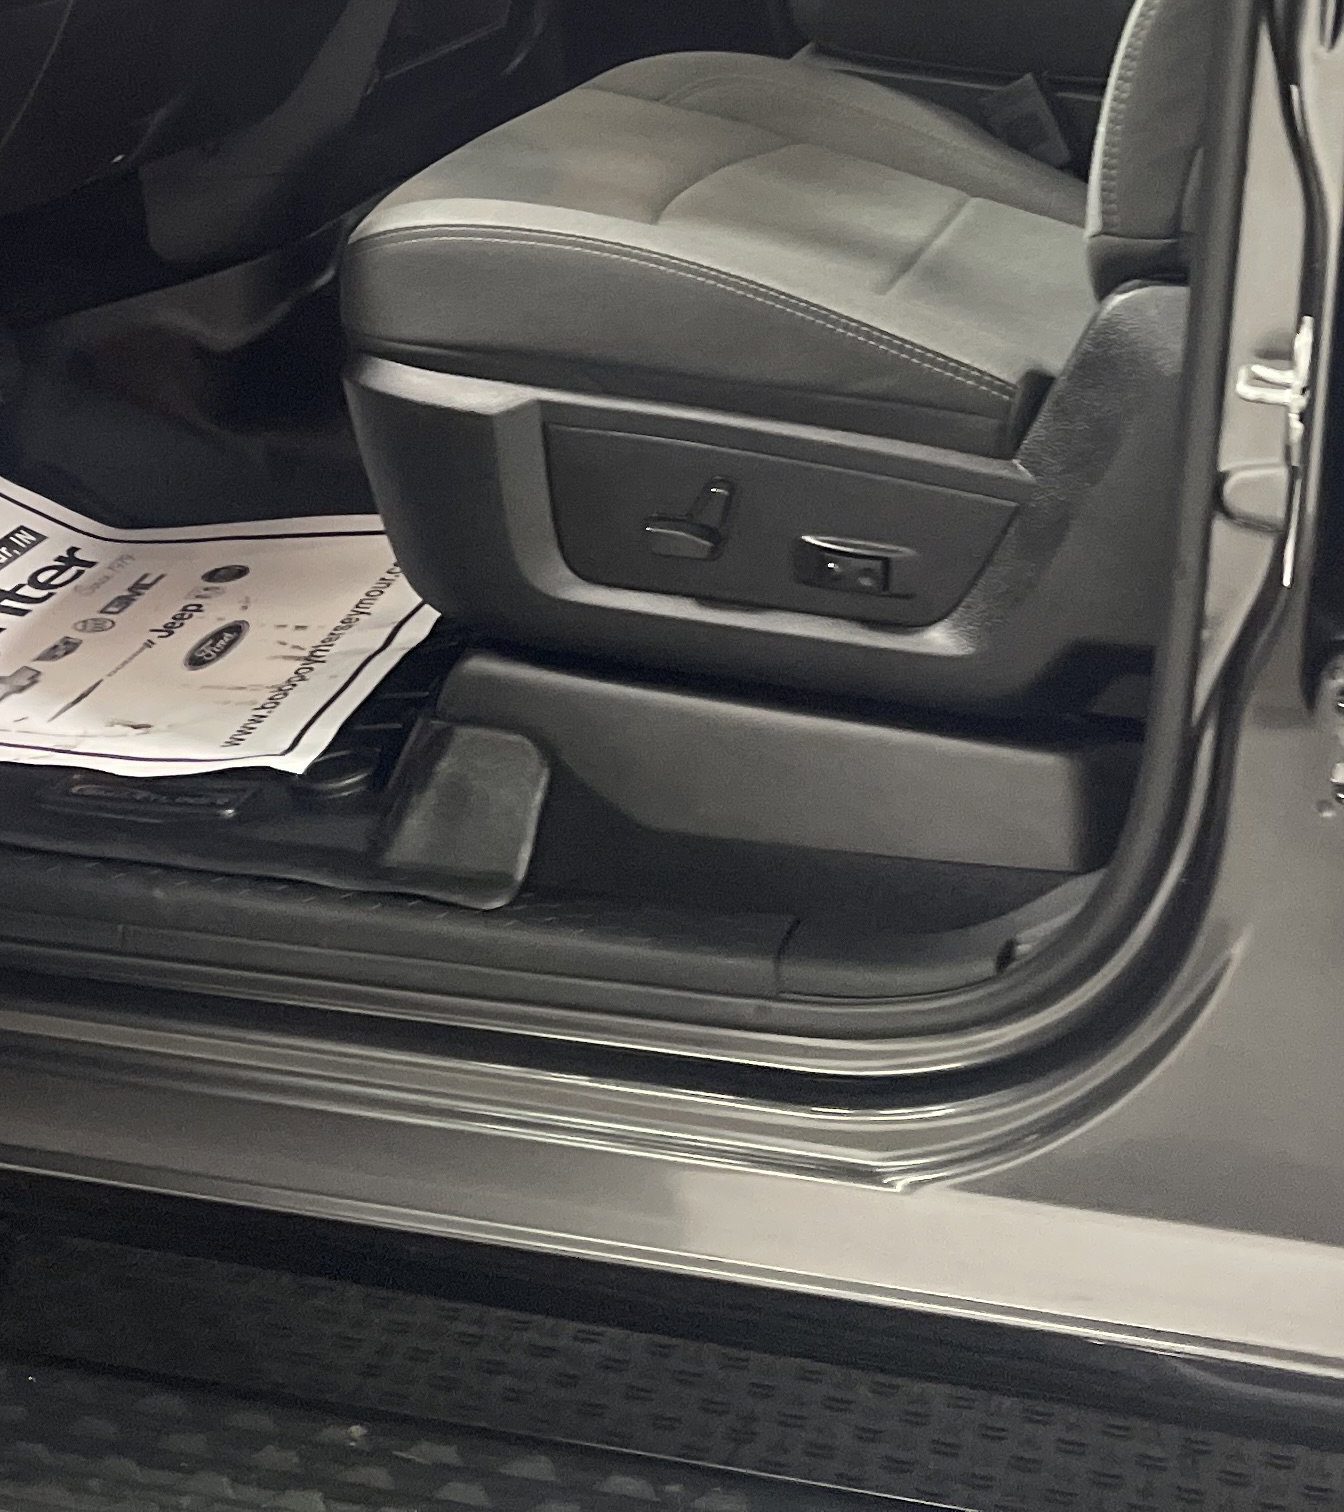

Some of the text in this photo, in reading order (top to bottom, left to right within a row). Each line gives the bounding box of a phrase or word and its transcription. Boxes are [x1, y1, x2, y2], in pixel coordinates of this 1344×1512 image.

[99, 572, 167, 615] GMC
[148, 603, 205, 639] Jeep
[219, 560, 404, 748] www.bobpoynterseymour.c
